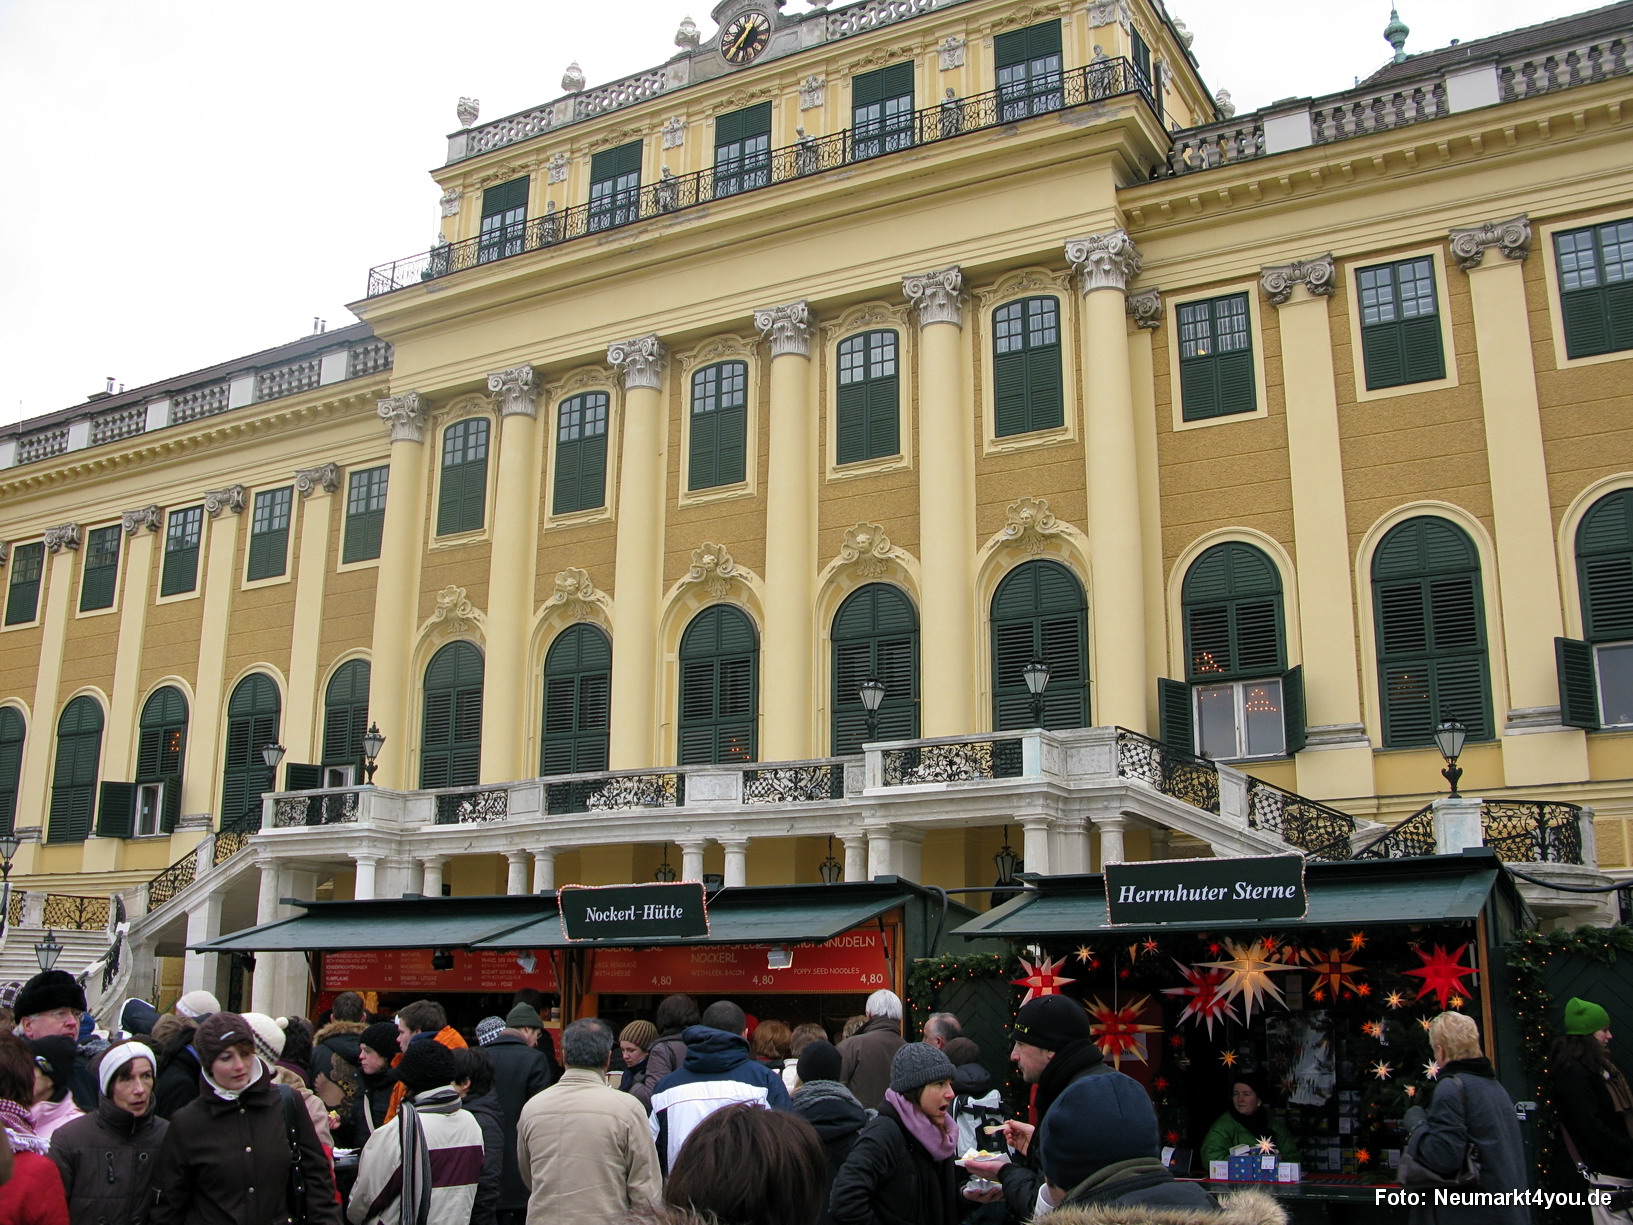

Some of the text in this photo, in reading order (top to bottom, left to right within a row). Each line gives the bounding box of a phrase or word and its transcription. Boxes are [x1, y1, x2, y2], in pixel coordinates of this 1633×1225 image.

[1118, 881, 1296, 904] Herrnhuter Sterne
[585, 904, 683, 922] Nockerl-Hütte
[691, 952, 738, 963] NOCKERL
[651, 976, 672, 987] 4,80
[752, 975, 774, 986] 4,80
[860, 973, 883, 985] 4,80
